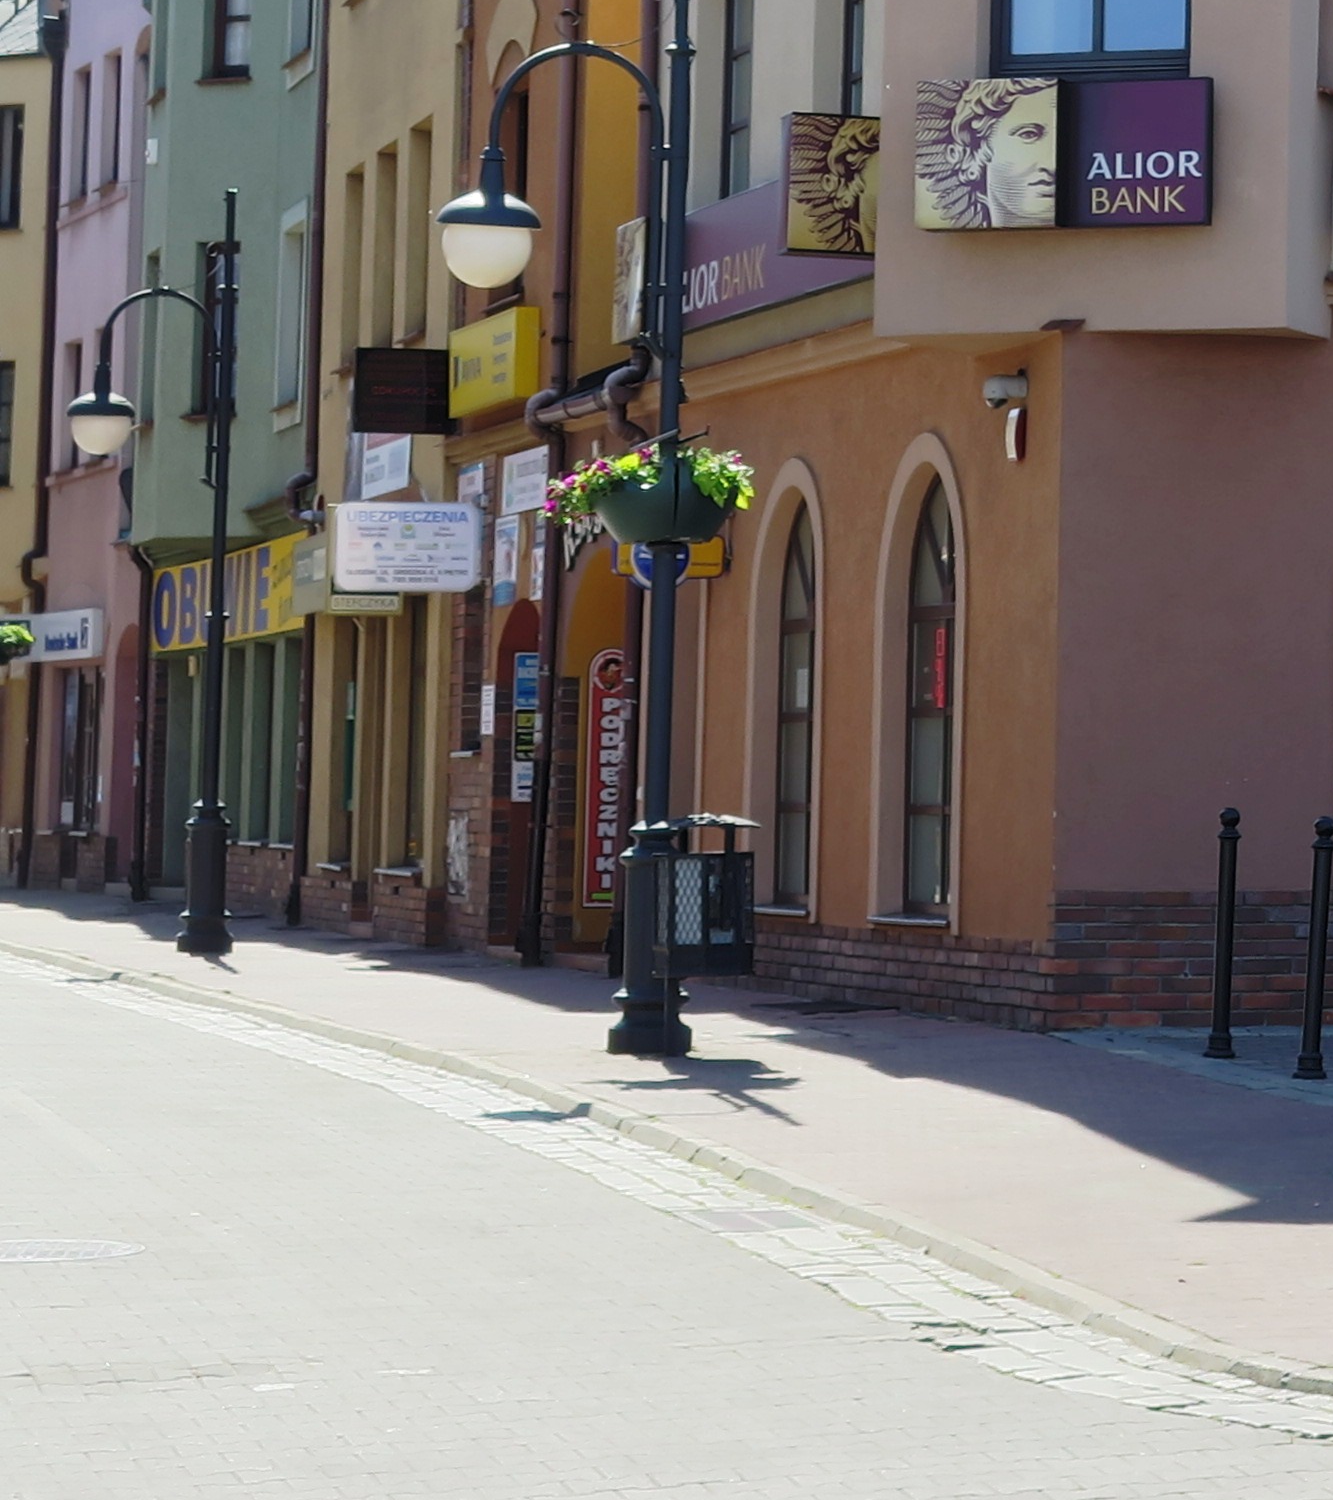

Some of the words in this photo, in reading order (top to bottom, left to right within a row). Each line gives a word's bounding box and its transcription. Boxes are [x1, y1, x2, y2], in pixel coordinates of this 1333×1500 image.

[1087, 150, 1202, 180] ALIOR
[1091, 185, 1186, 214] BANK
[681, 260, 719, 314] LIOR
[721, 243, 767, 301] BANK
[346, 510, 469, 524] UBEZPIECZENIA
